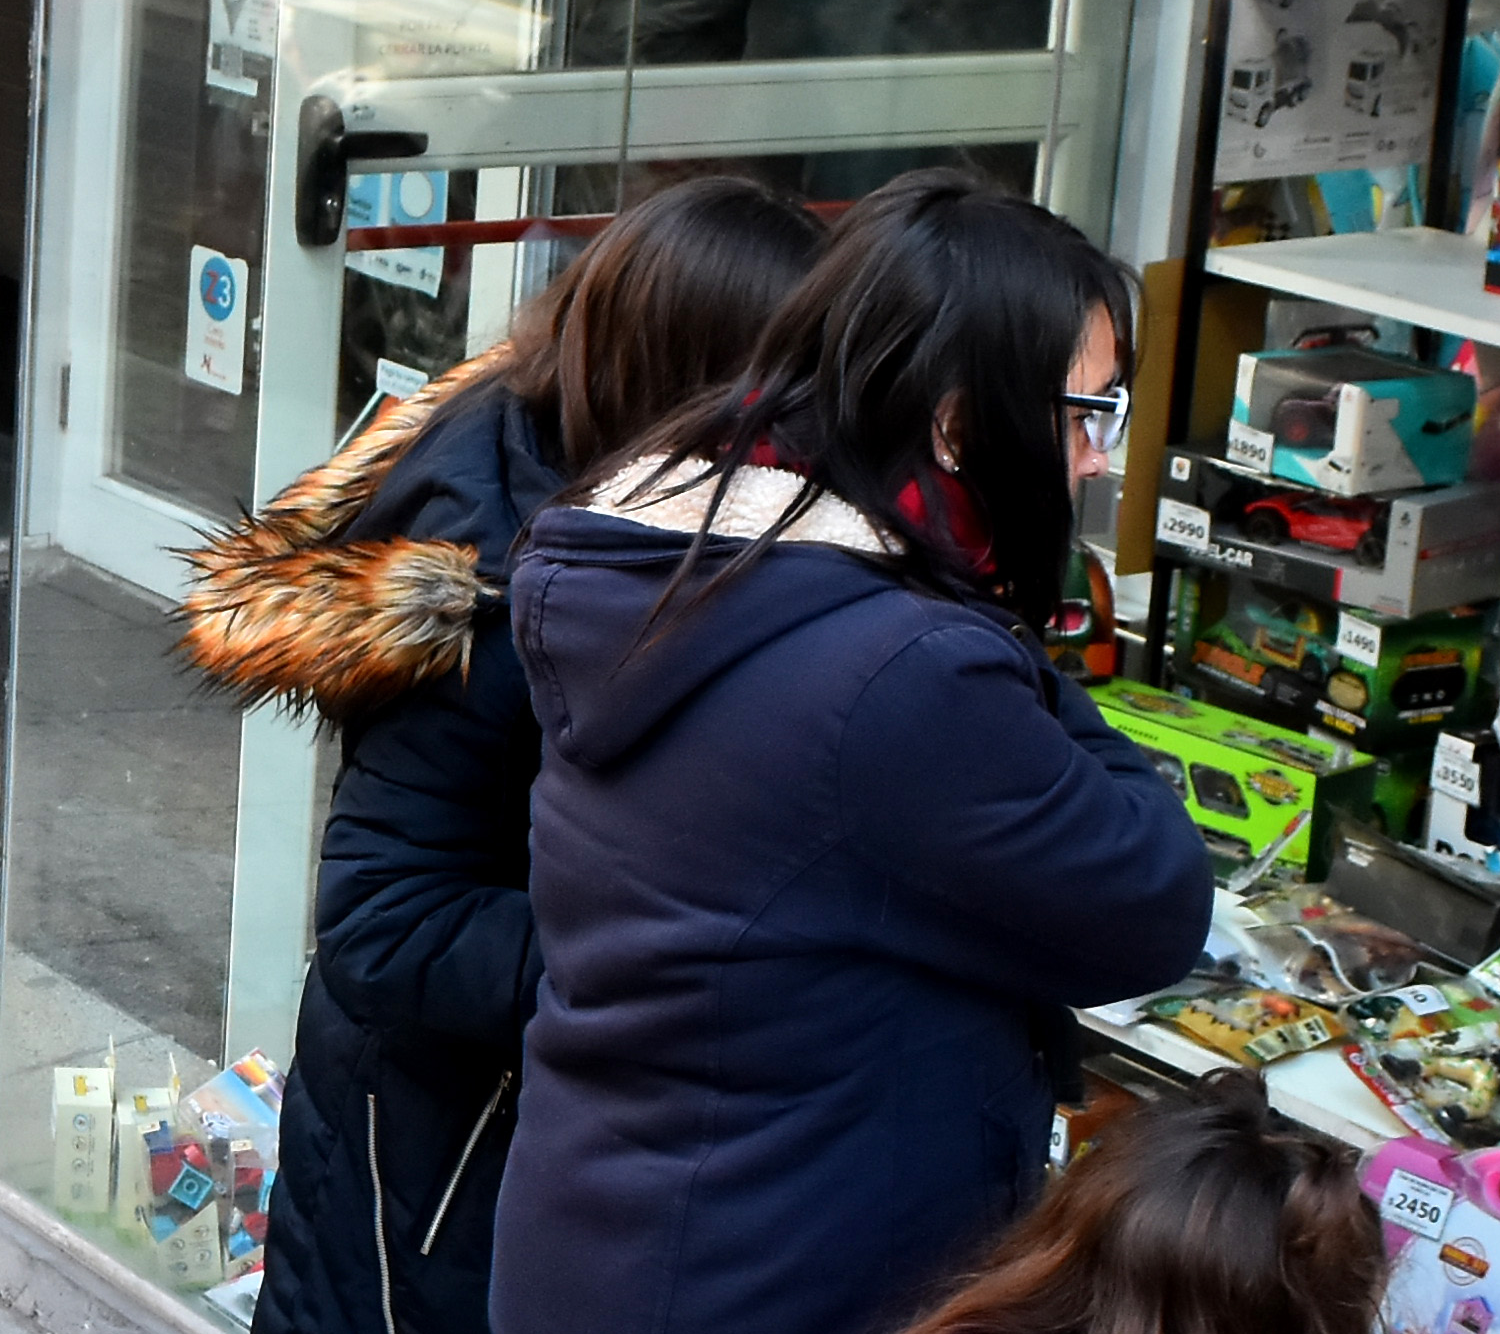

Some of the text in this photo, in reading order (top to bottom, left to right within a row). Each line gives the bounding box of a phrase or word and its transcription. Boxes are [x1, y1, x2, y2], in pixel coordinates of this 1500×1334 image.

[203, 269, 232, 307] Z3
[1163, 517, 1205, 540] $2990
[1387, 1192, 1441, 1224] $2450
